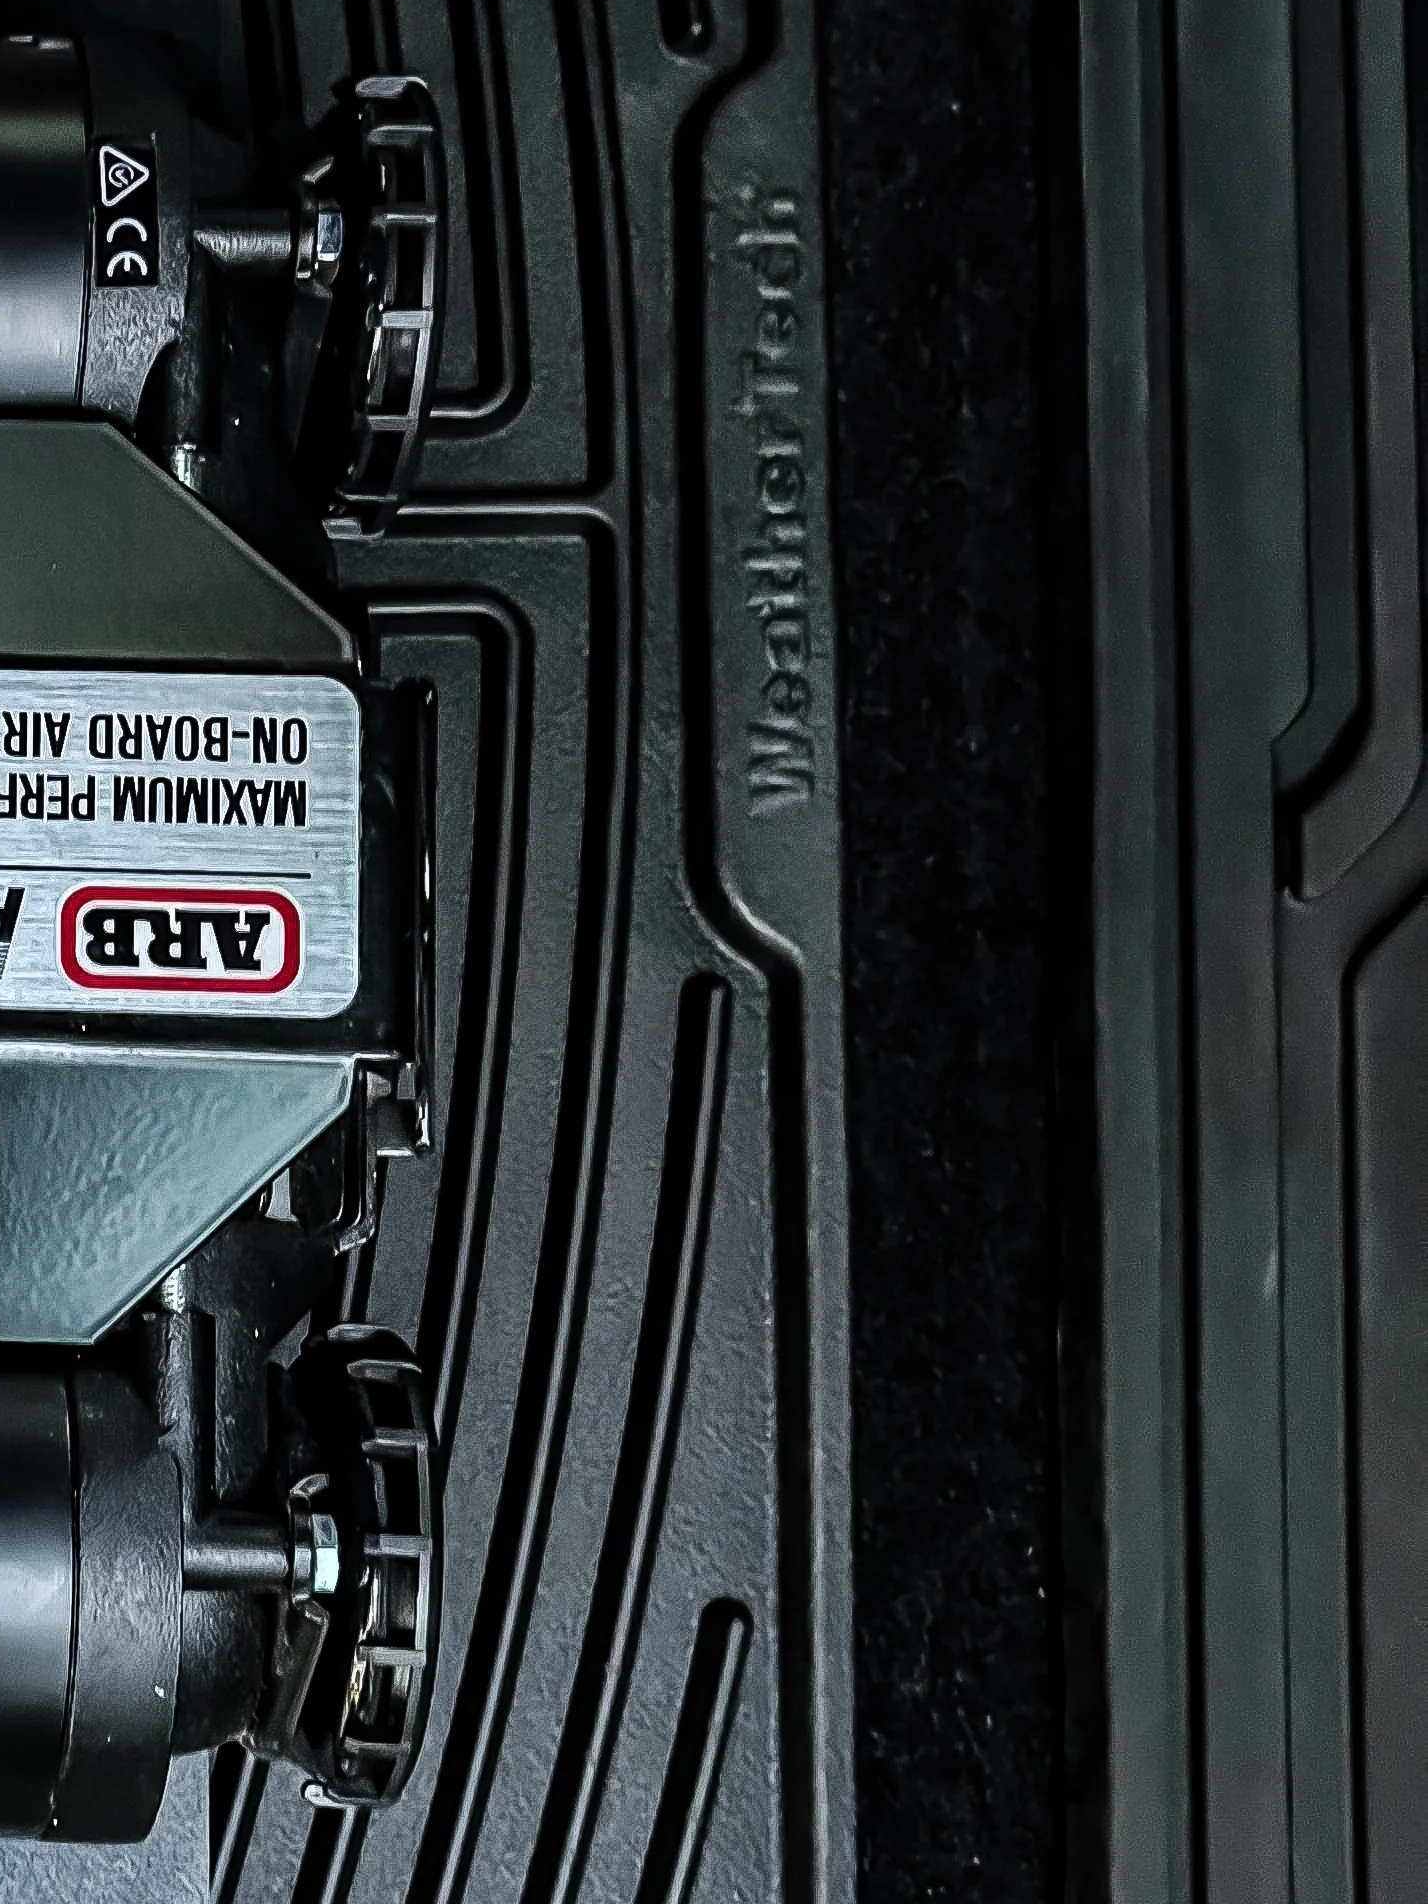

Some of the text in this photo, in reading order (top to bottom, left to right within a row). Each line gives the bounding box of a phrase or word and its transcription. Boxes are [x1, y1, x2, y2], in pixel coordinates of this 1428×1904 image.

[3, 711, 71, 758] AIR
[89, 713, 307, 764] ON-BOARD
[113, 775, 307, 827] MAXIMUM
[80, 902, 272, 973] ARB
